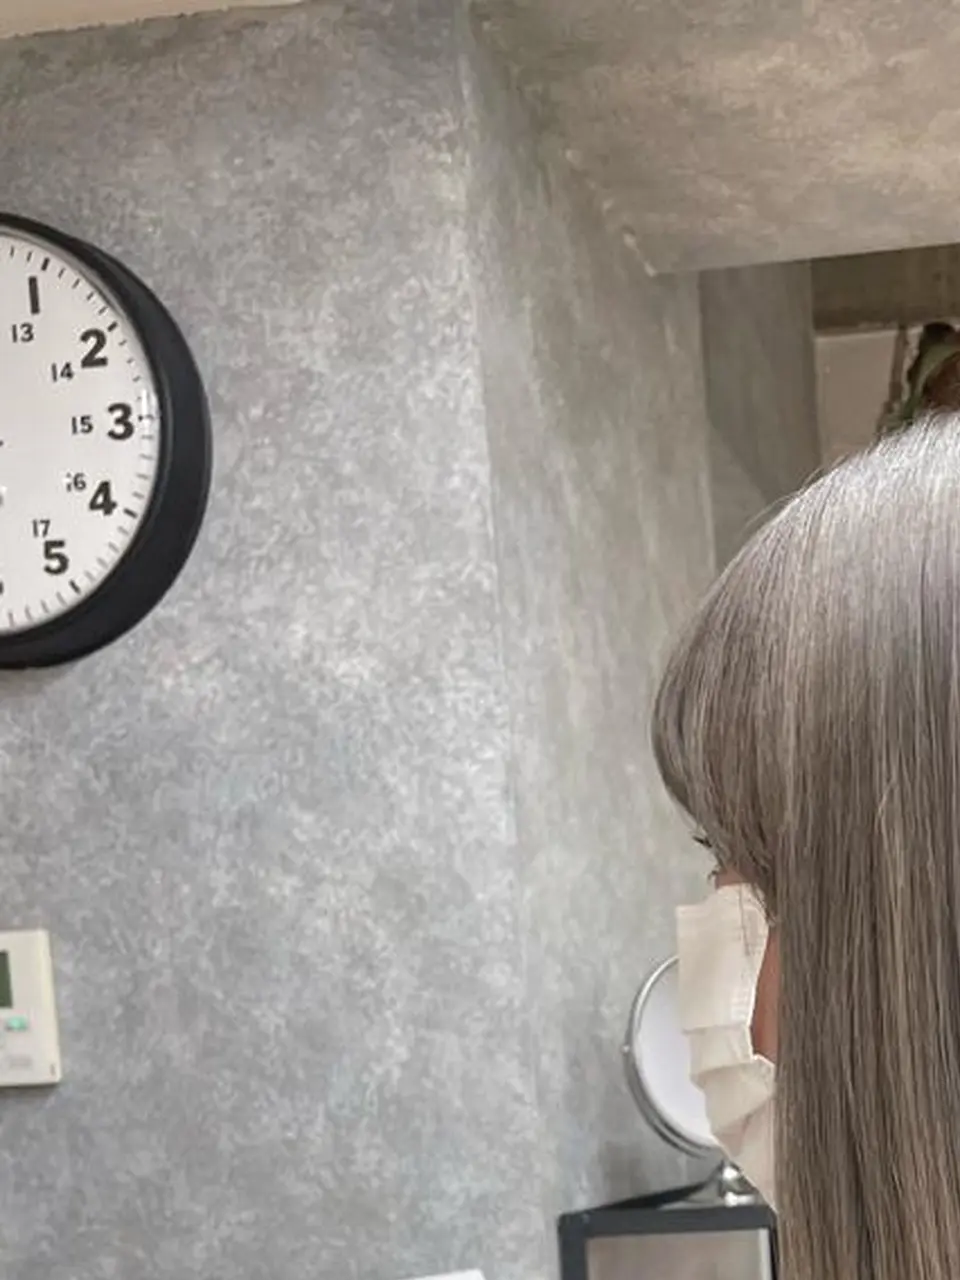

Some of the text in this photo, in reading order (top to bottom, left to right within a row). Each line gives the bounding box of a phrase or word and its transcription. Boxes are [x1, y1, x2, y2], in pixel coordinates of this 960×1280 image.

[29, 276, 40, 314] 1
[11, 322, 35, 343] 13
[80, 328, 109, 368] 2
[51, 362, 74, 382] 14
[71, 416, 93, 434] 15
[107, 403, 134, 440] 3
[88, 480, 117, 515] 4
[33, 519, 51, 538] 17
[43, 540, 69, 575] 5
